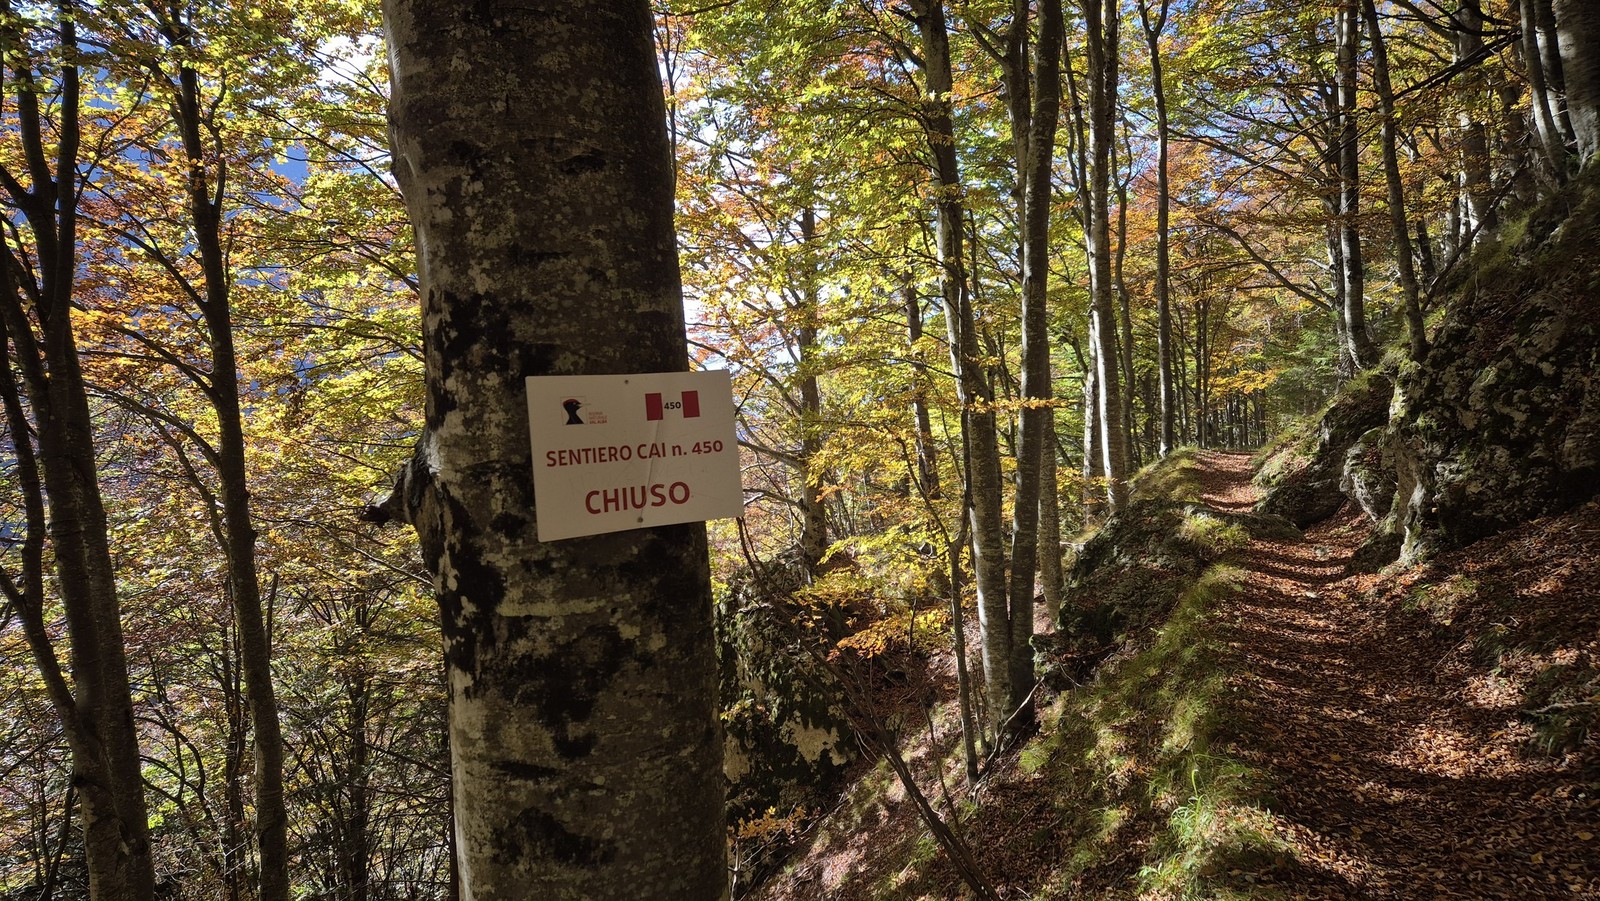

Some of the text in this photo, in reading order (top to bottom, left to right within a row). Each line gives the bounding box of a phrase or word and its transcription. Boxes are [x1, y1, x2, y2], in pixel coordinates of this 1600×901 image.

[664, 402, 681, 410] 450
[546, 440, 723, 467] SENTIERO CAI n. 450
[585, 481, 690, 514] CHIUSO
